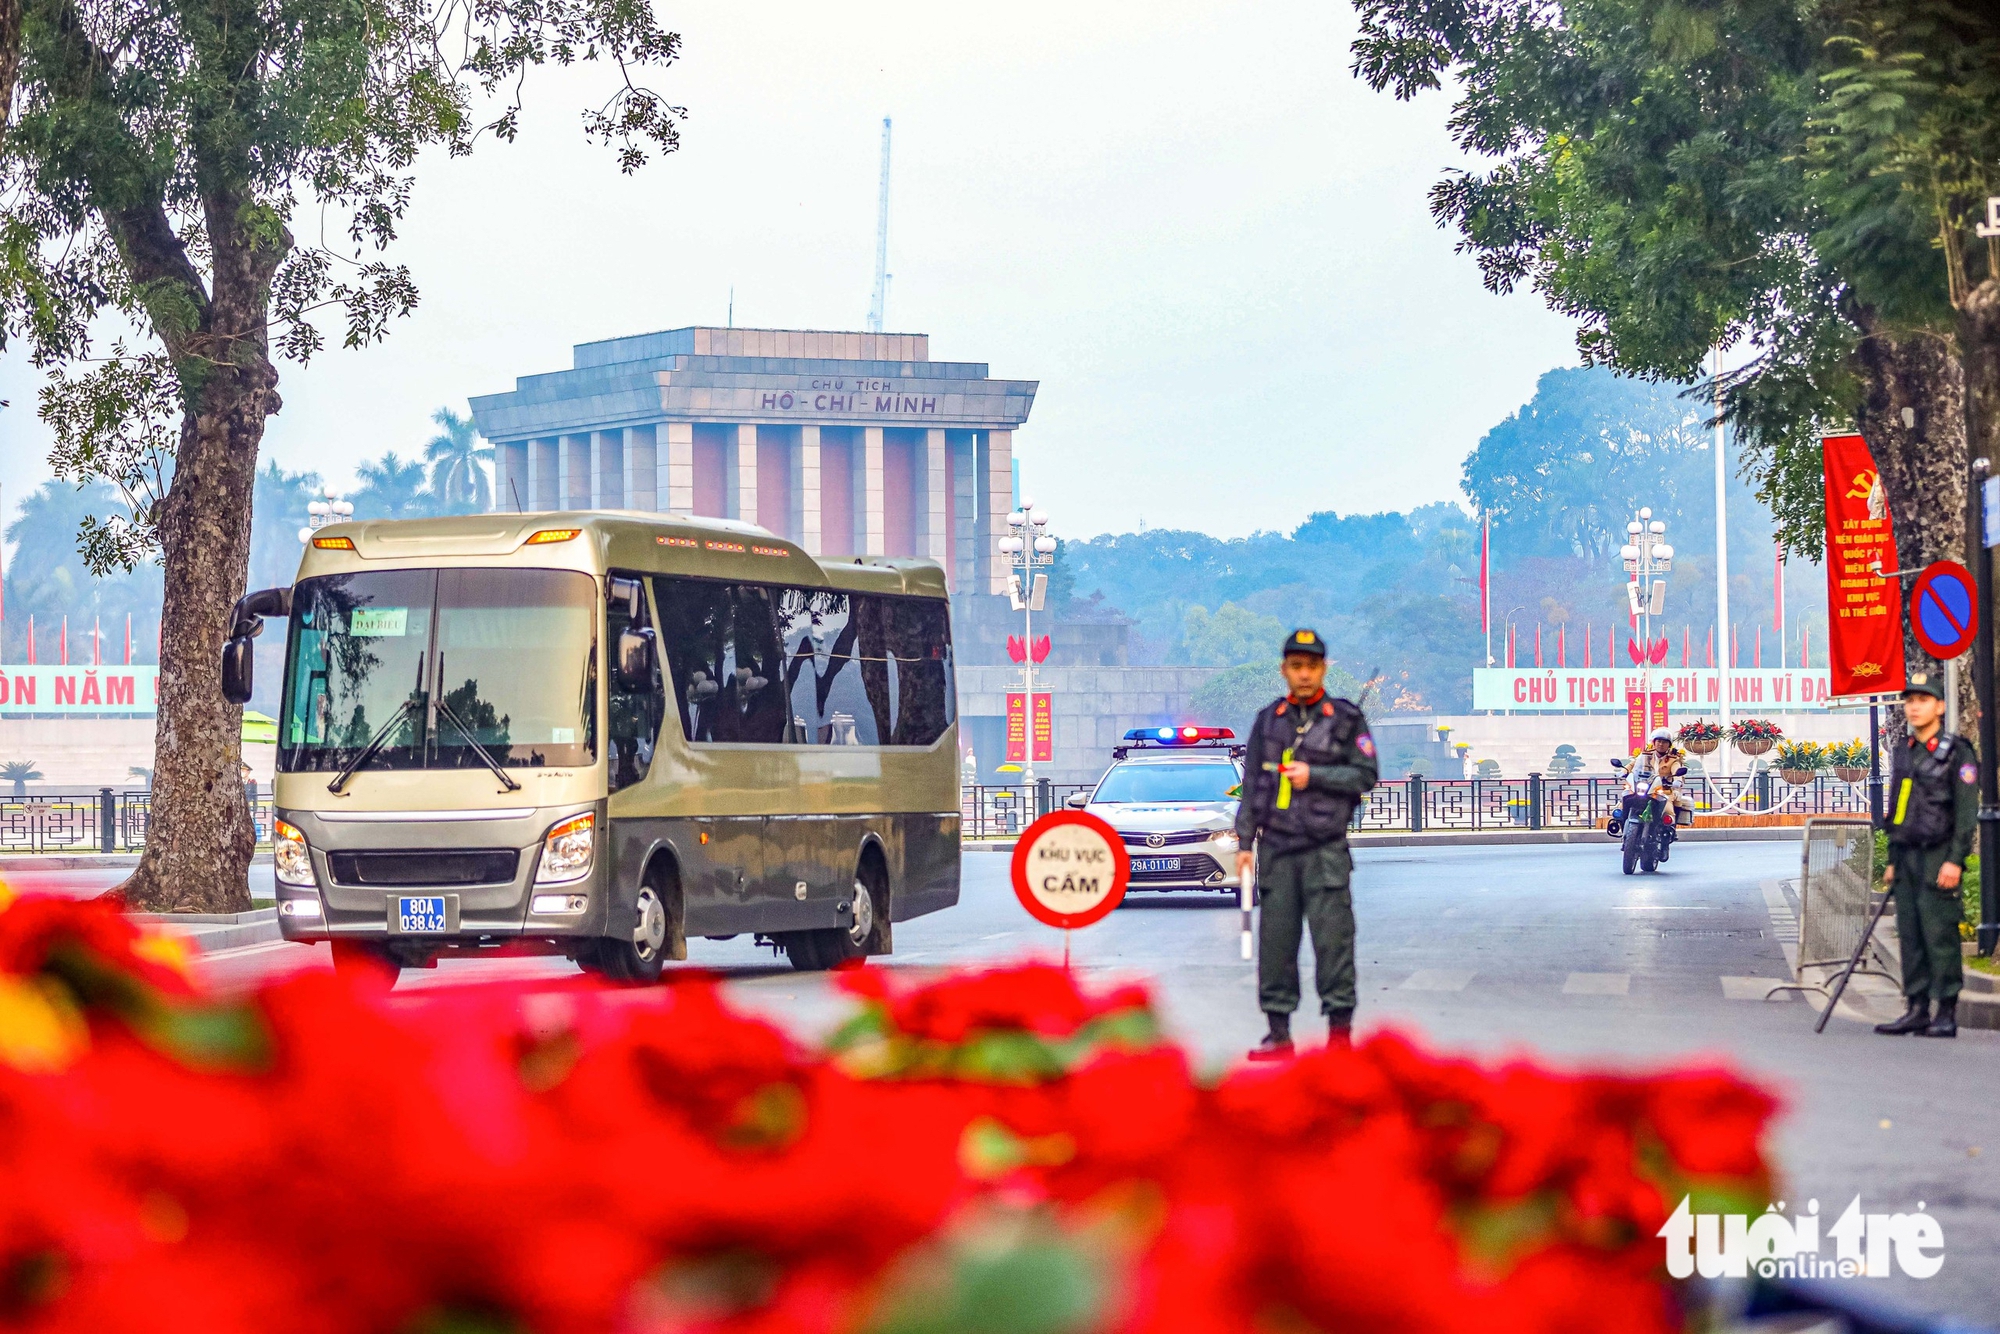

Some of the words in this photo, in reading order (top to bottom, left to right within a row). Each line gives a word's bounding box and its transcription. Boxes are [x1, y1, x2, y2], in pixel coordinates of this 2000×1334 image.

[1842, 519, 1859, 529] XÂY
[1835, 533, 1852, 544] NỀN
[1853, 533, 1873, 543] GIÁO
[1875, 533, 1889, 544] DỤC
[1843, 547, 1865, 559] QUỐC
[1845, 563, 1864, 575] HIỆN
[1840, 579, 1868, 588] NGANG
[1847, 594, 1864, 602] KHU
[1865, 592, 1880, 603] VỰC
[1839, 606, 1850, 617] VÀ
[1852, 605, 1867, 617] THẾ
[54, 670, 135, 705] NĂM
[1514, 670, 1557, 703] CHỦ
[1566, 677, 1615, 707] TỊCH
[1662, 672, 1697, 703] CHÍ
[1772, 673, 1792, 702] VĨ
[1801, 677, 1834, 707] ĐẠ
[1039, 848, 1070, 862] KHU
[1043, 870, 1099, 893] CẤM
[410, 899, 434, 914] 80A
[401, 915, 443, 930] 038.42
